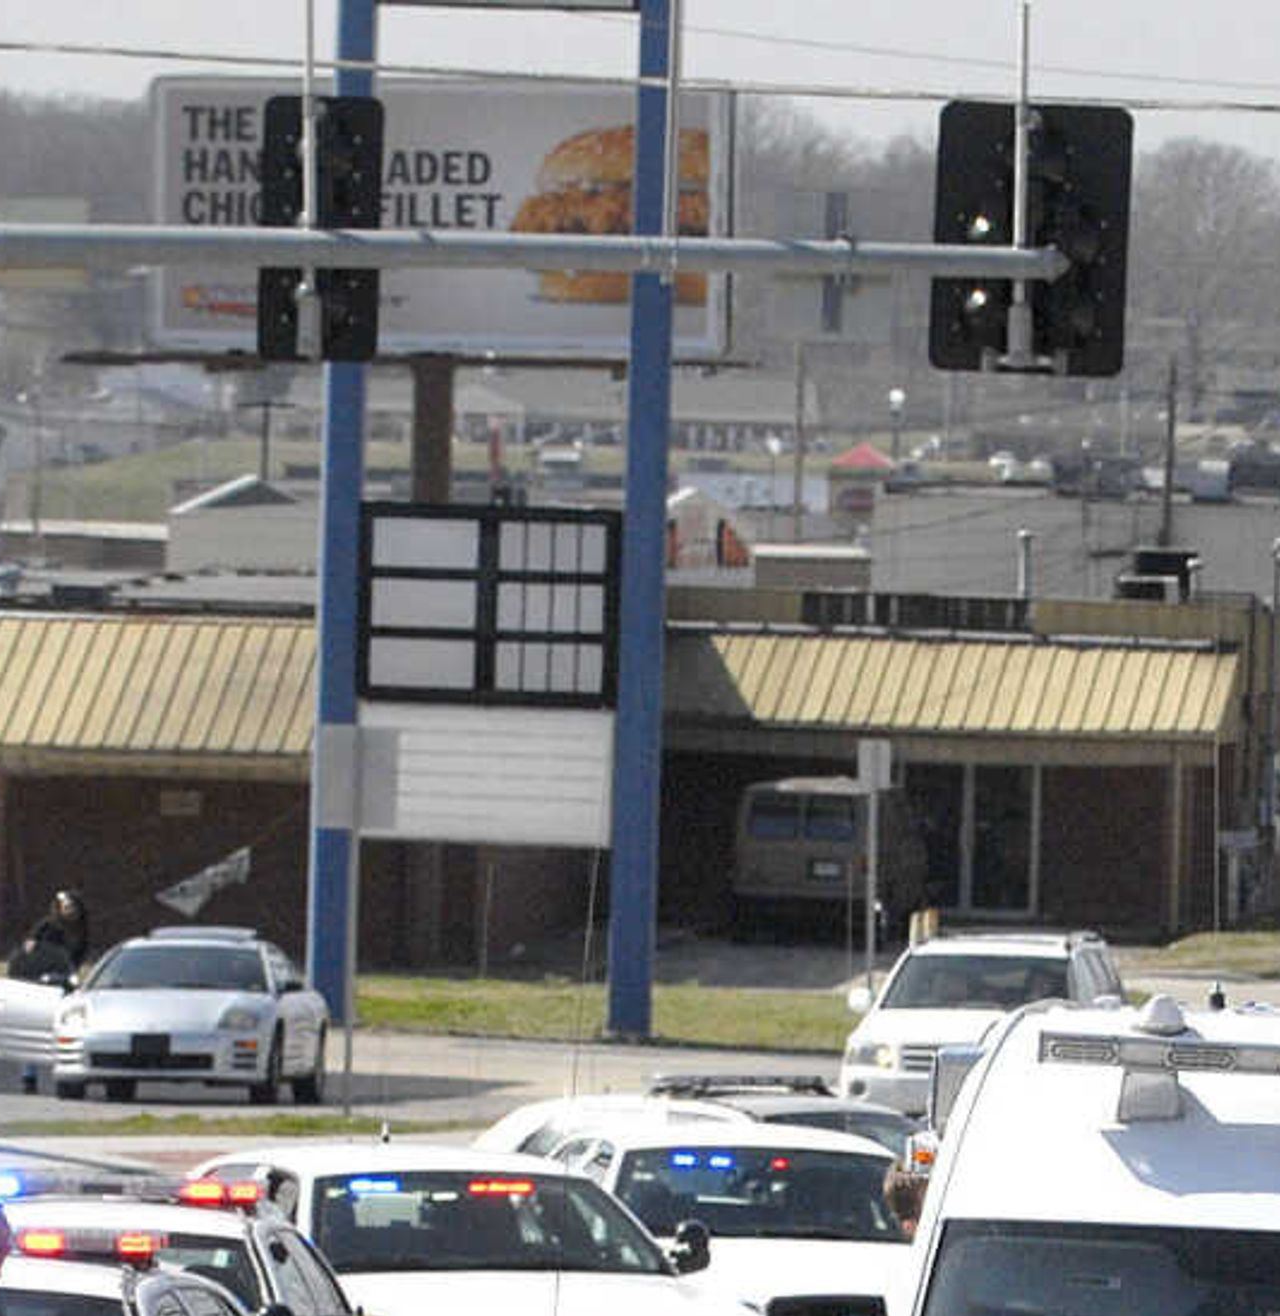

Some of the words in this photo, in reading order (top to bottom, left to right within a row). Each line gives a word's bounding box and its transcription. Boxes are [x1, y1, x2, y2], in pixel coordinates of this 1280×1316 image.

[182, 106, 256, 142] THE
[184, 150, 266, 184] HAN
[384, 151, 492, 186] ADED
